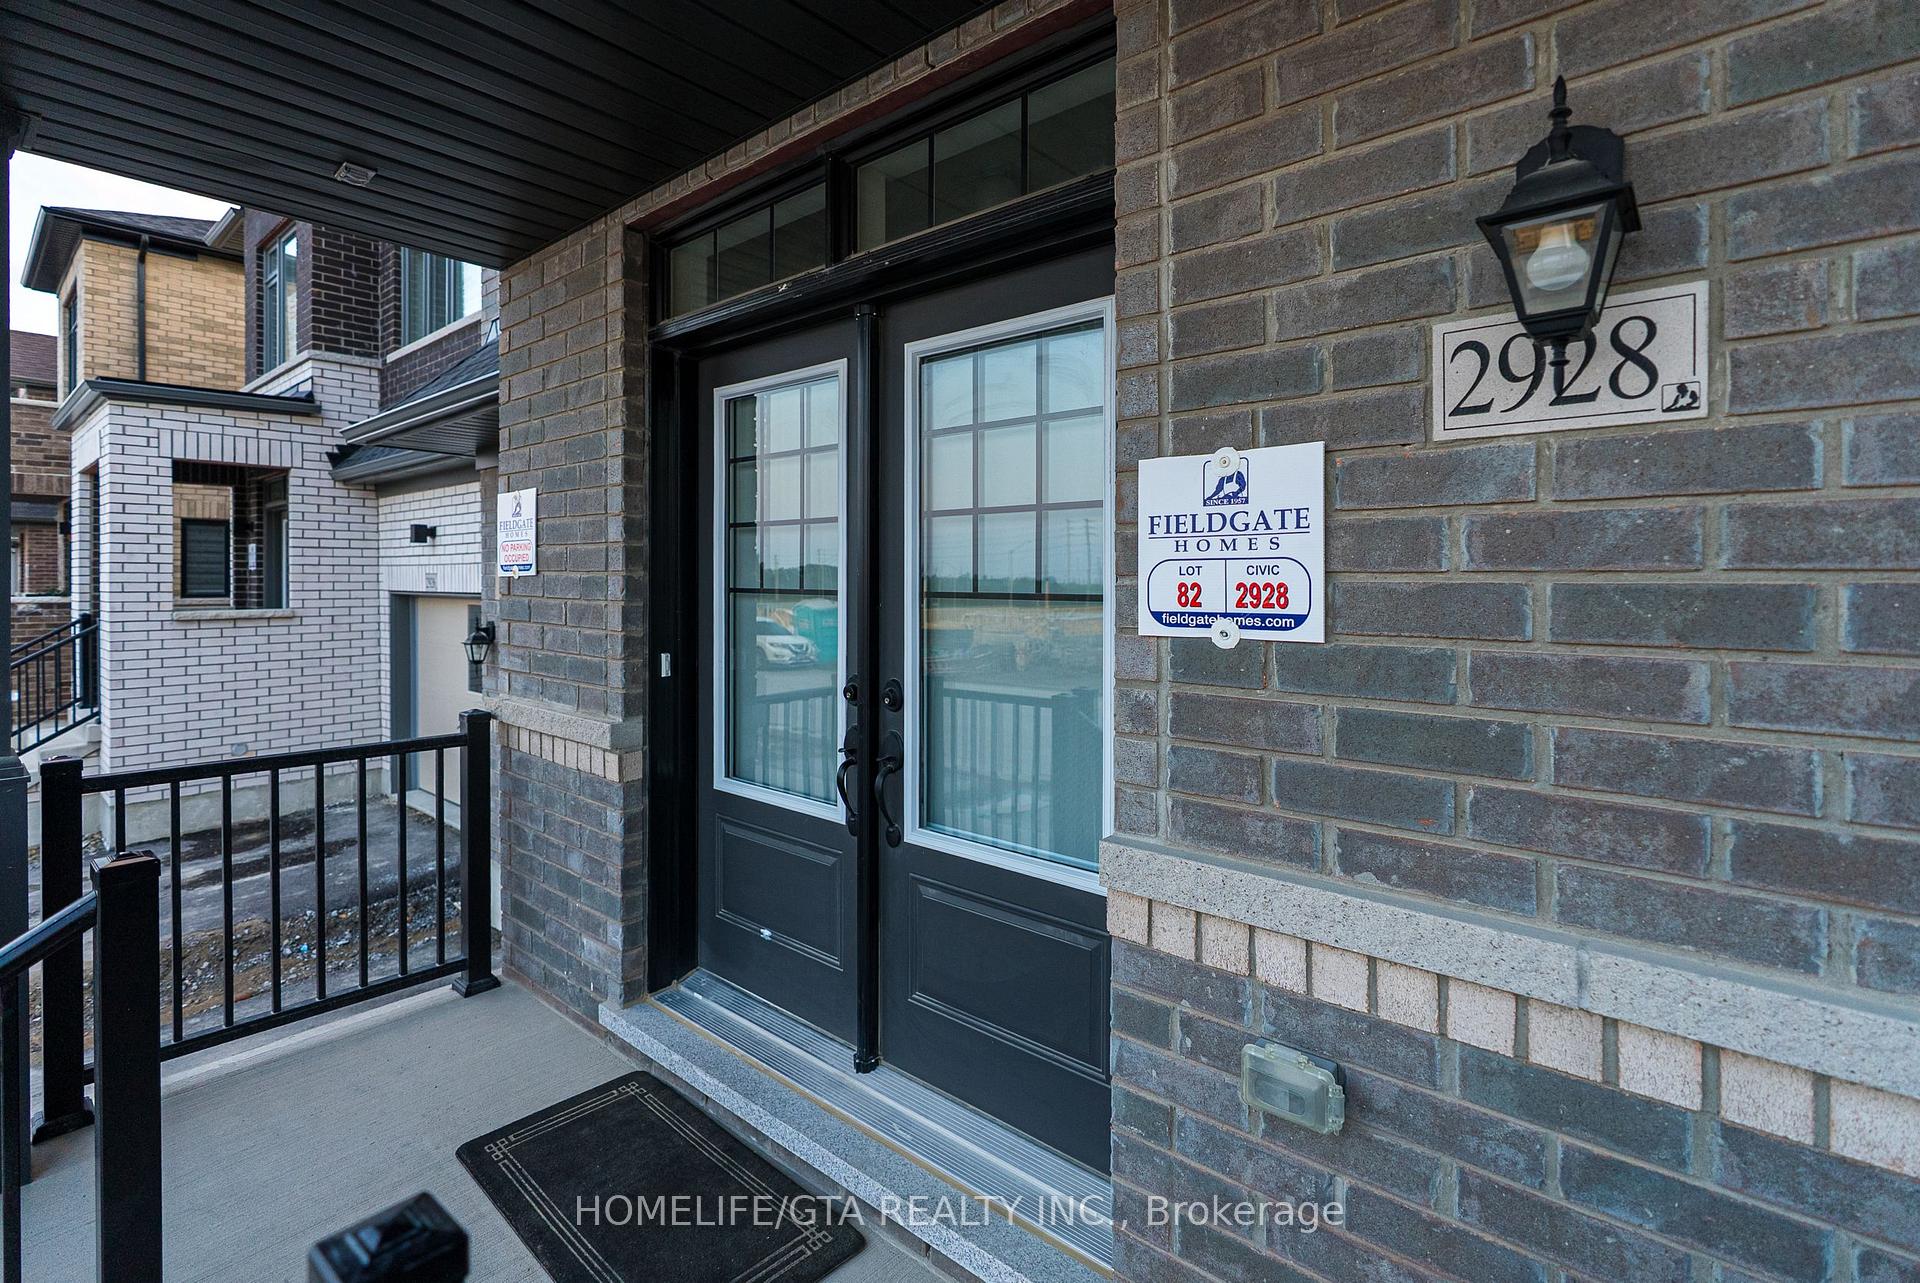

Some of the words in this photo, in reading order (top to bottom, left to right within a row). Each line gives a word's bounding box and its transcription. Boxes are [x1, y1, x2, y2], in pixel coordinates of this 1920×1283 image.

[1449, 315, 1659, 417] 2928
[1205, 498, 1229, 506] SINCE
[1231, 497, 1246, 505] 1957
[500, 518, 533, 530] FIELDGATE
[1148, 507, 1311, 535] FIELDGATE
[502, 544, 509, 552] NO
[510, 543, 531, 552] PARKING
[1174, 537, 1280, 552] HOMES
[504, 554, 529, 563] OCCUPIED
[1179, 566, 1202, 576] LOT
[1246, 565, 1280, 576] CIVIC
[1177, 581, 1202, 608] 82
[1235, 582, 1289, 610] 2928
